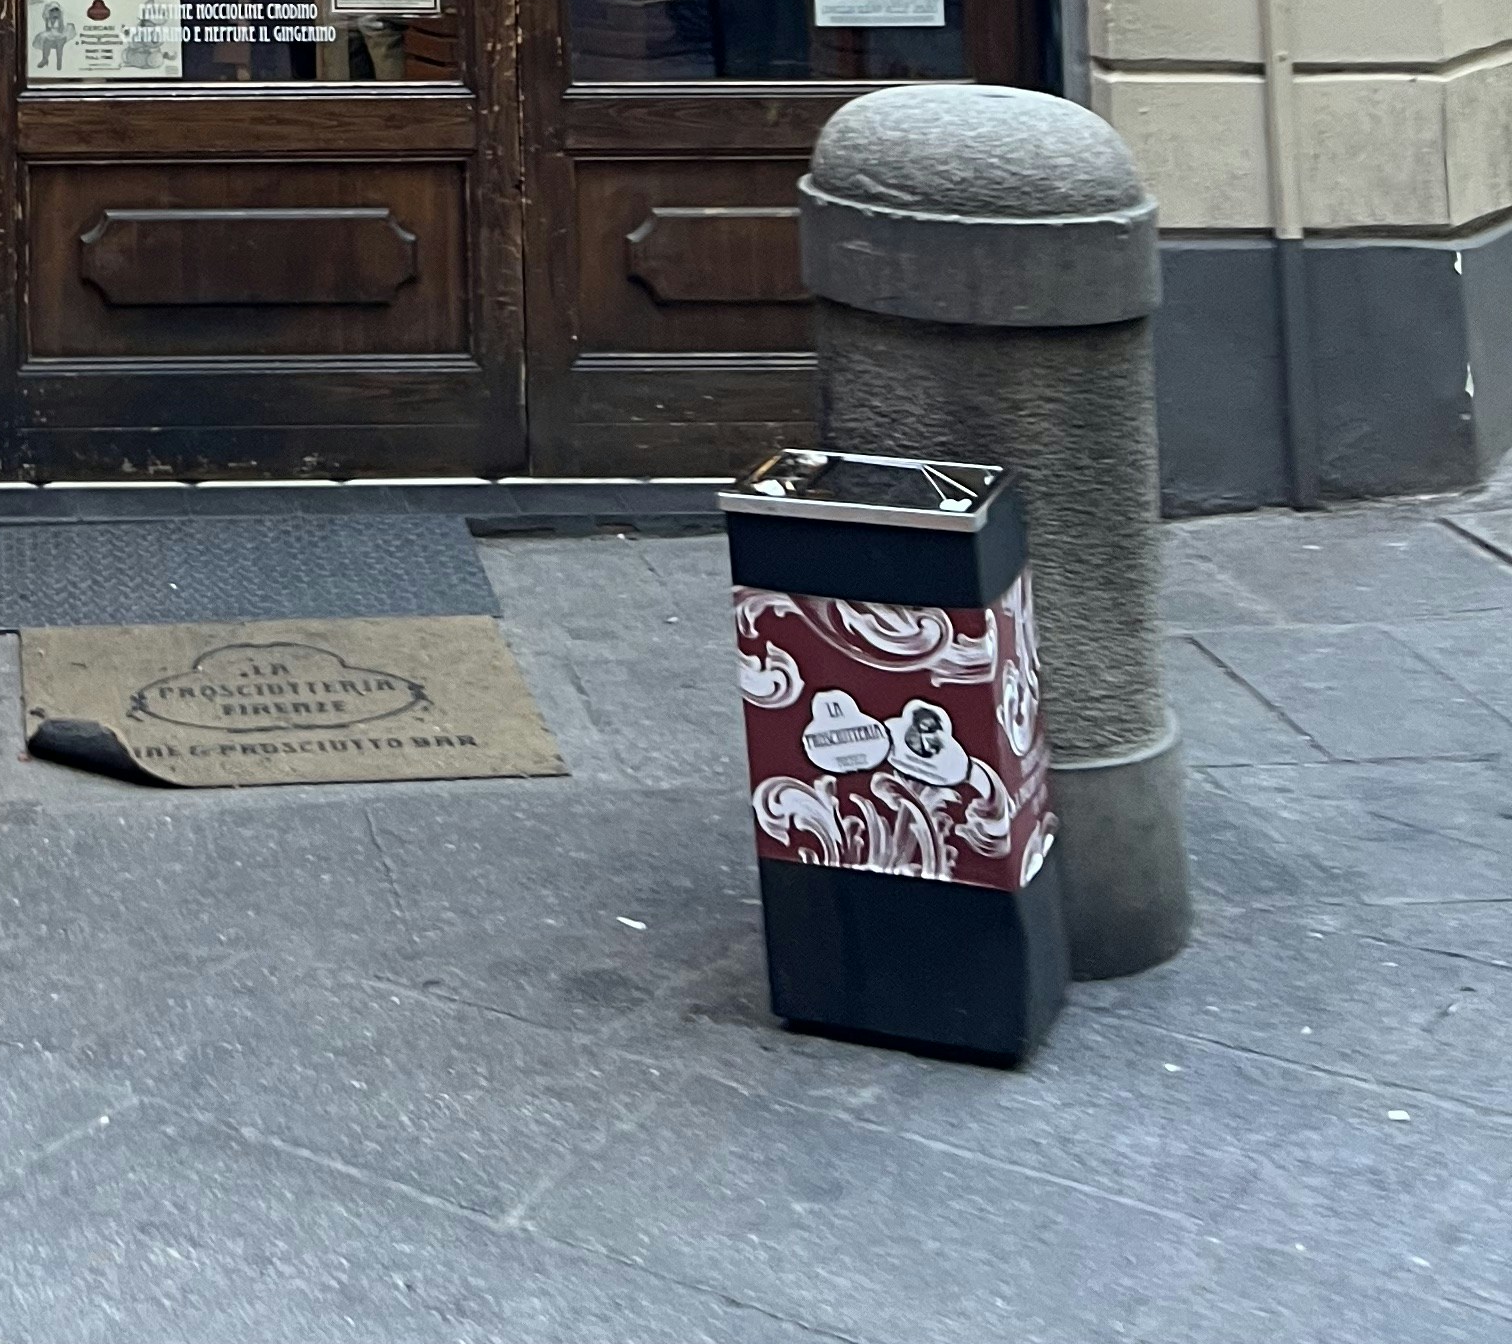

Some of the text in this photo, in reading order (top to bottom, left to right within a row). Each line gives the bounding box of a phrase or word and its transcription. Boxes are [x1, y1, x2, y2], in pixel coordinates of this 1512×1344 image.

[196, 3, 265, 19] NOCCIOLINE
[267, 3, 318, 19] CRODINO
[194, 26, 202, 42] E
[204, 26, 257, 42] NEPPURE
[259, 26, 271, 42] IL
[273, 26, 337, 42] GINGERINO
[159, 677, 396, 702] PROSCIUTTERIA
[221, 699, 346, 717] FIRENZE
[825, 701, 844, 718] LA
[219, 737, 403, 757] PROSCIUTTO
[410, 733, 478, 750] BAR
